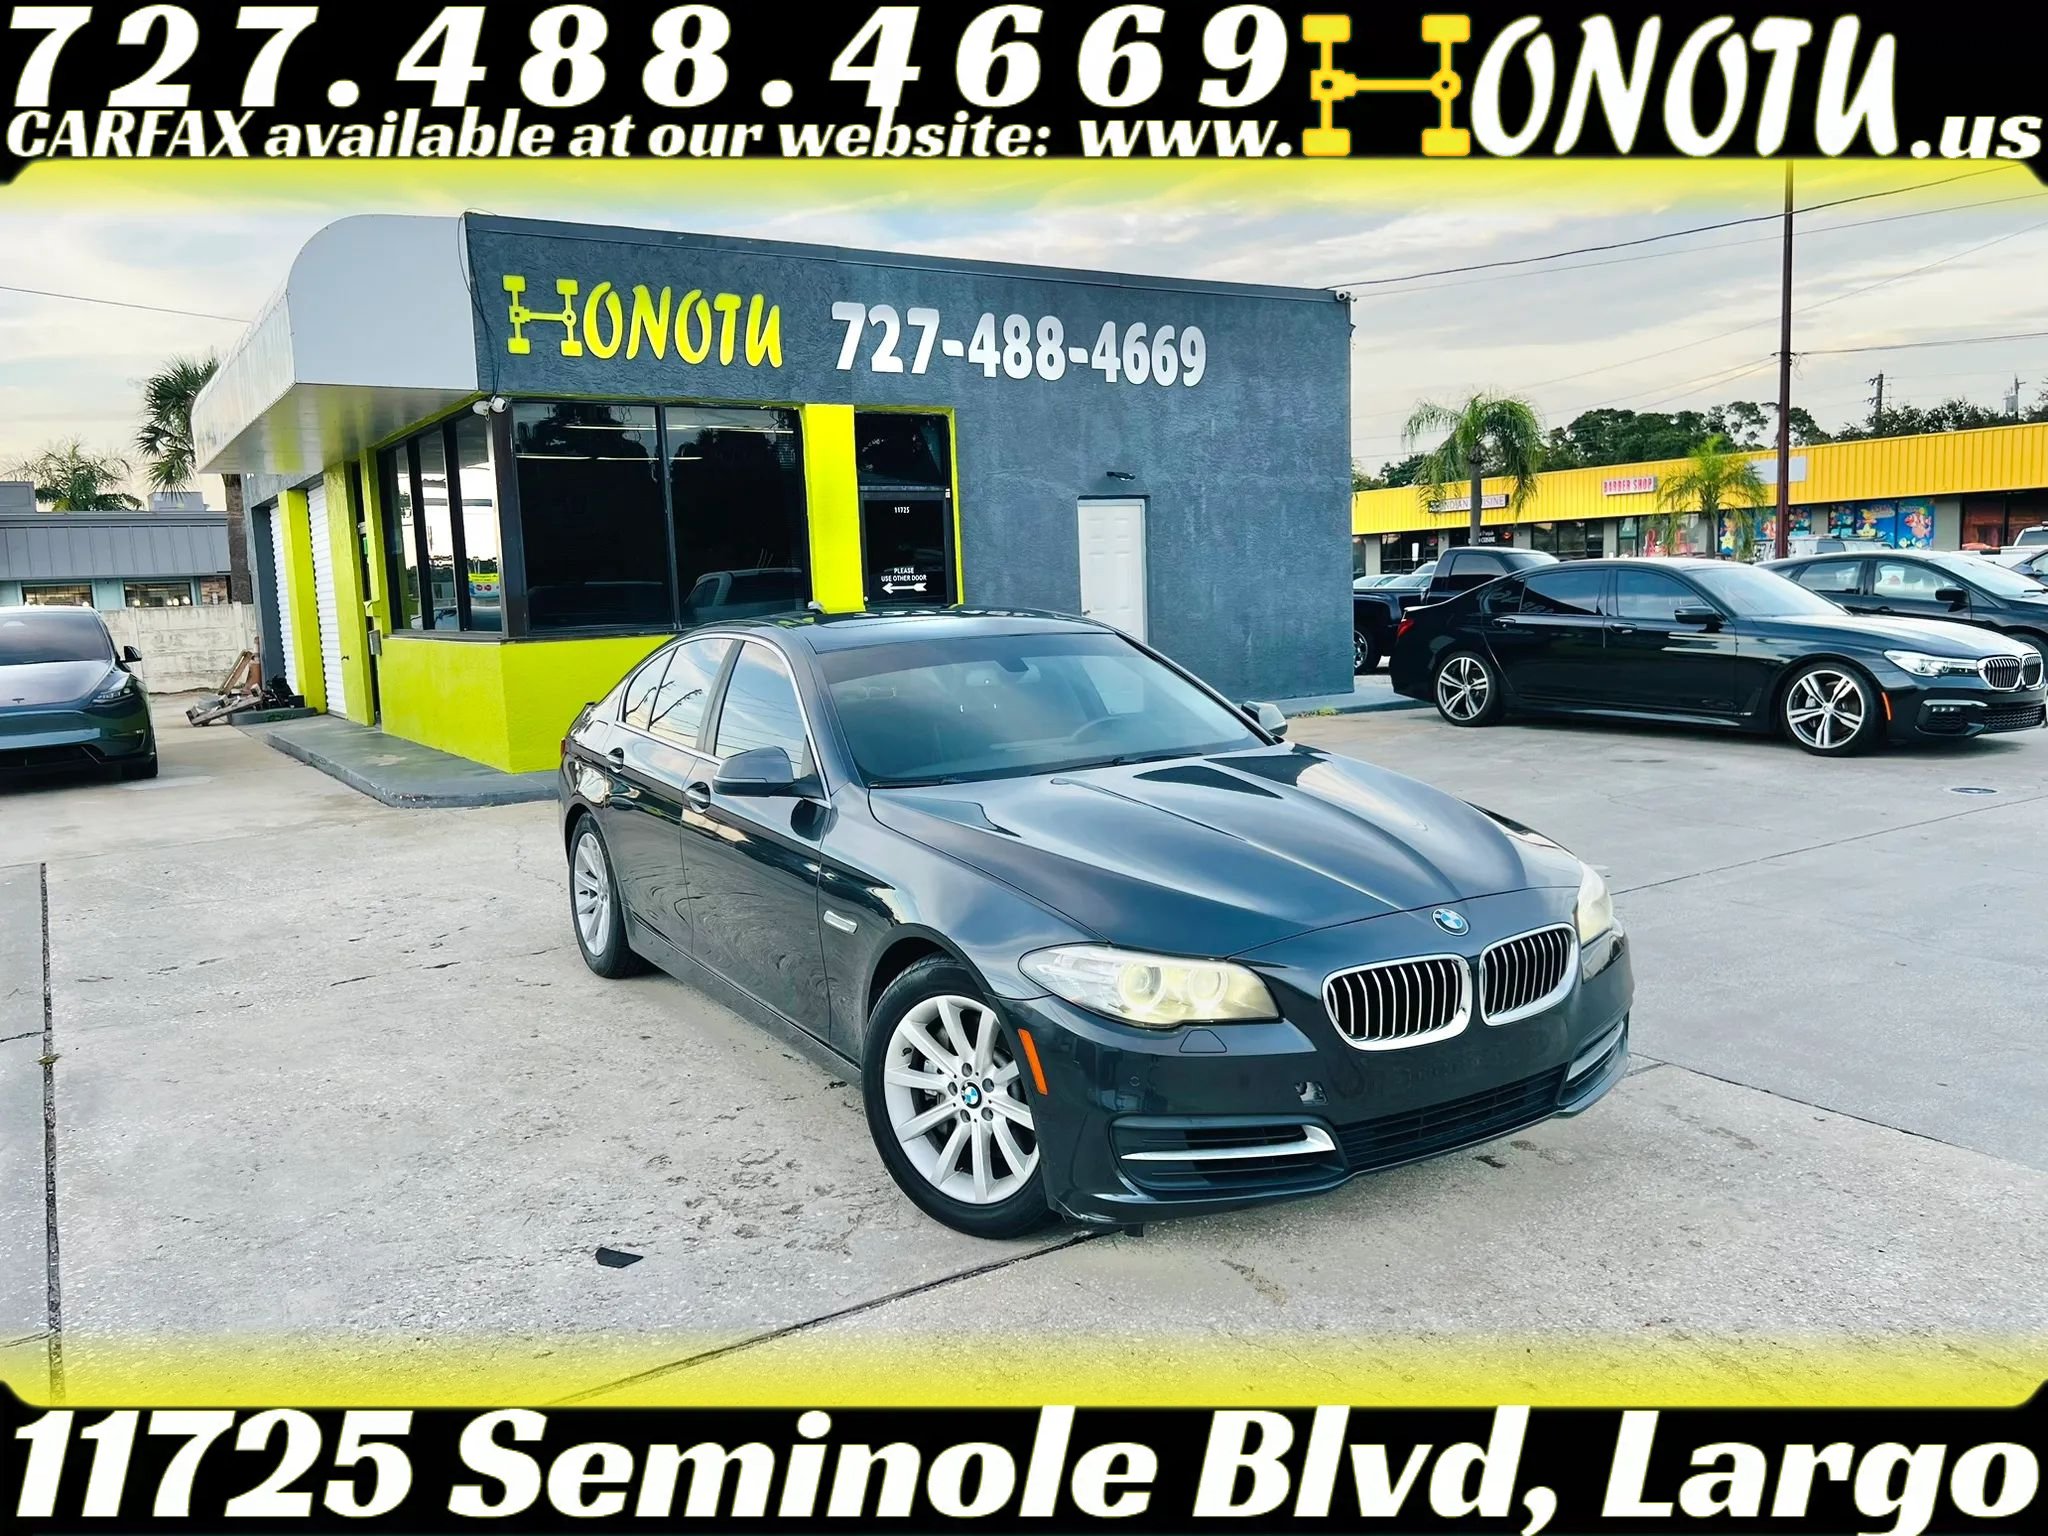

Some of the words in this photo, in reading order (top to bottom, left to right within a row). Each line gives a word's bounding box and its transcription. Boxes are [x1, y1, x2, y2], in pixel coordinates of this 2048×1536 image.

[831, 301, 1207, 387] 727-488-4669
[1604, 480, 1631, 493] BARBER
[1633, 478, 1652, 491] SHOP
